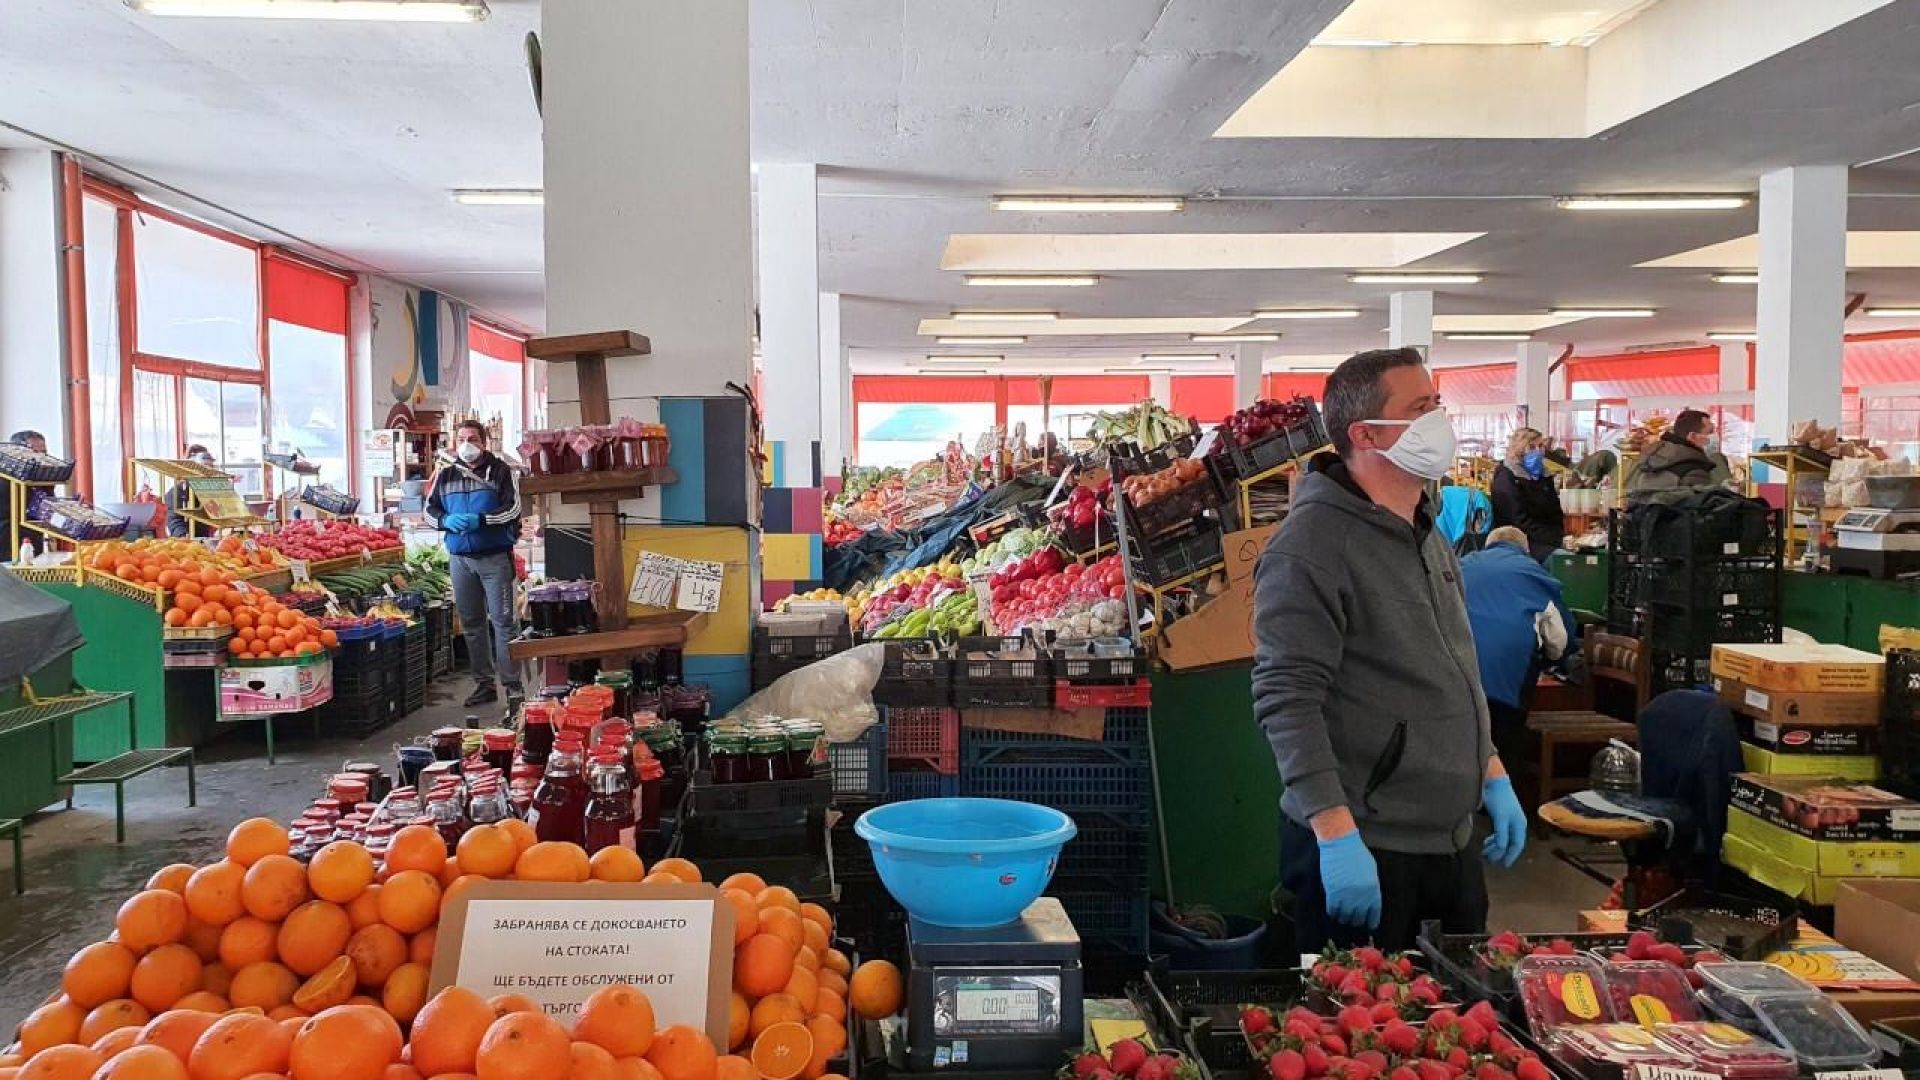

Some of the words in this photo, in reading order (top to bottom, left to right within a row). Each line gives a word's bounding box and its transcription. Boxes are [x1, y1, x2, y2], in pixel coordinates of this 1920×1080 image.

[493, 919, 569, 931] ЗАБРАНЯВА
[573, 919, 588, 931] СЕ
[590, 918, 687, 932] ДОКОСВАНЕТО
[545, 946, 563, 957] НА
[566, 944, 630, 957] СТОКАТА!
[493, 975, 515, 988] ЩЕ
[518, 975, 568, 988] БЪДЕТЕ
[572, 974, 654, 986] ОБСЛУЖЕНИ
[657, 973, 675, 985] ОТ
